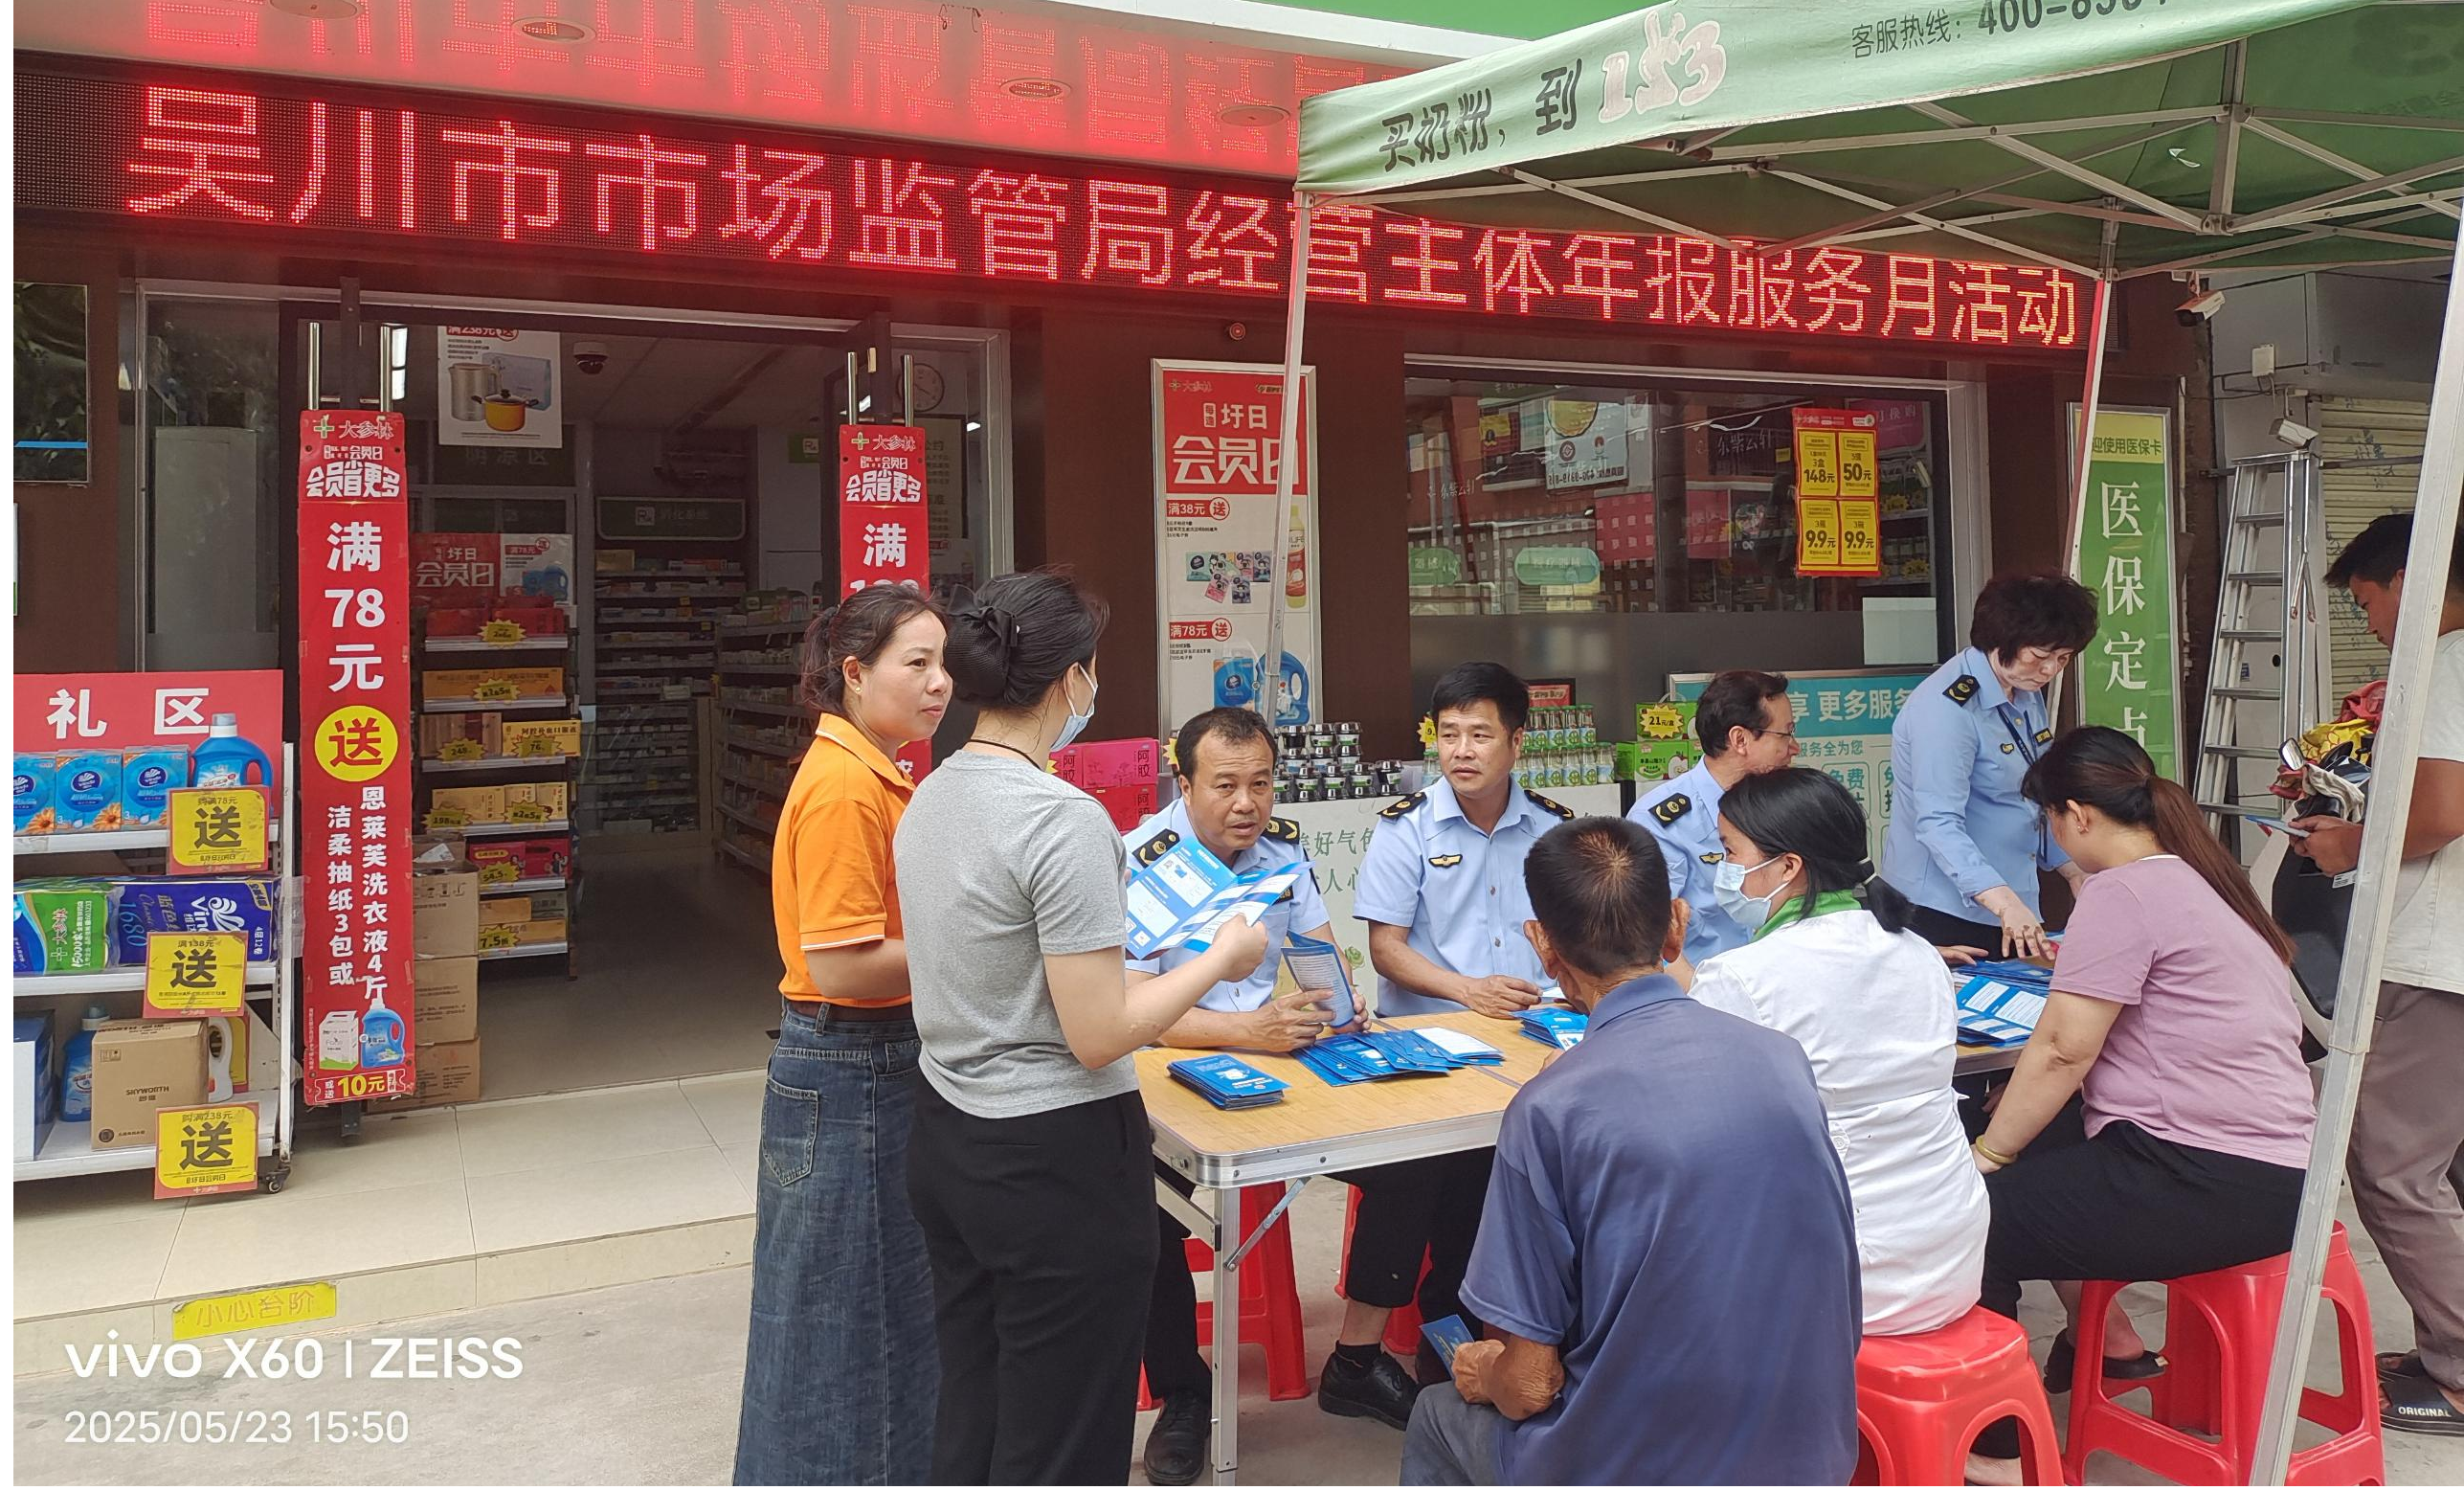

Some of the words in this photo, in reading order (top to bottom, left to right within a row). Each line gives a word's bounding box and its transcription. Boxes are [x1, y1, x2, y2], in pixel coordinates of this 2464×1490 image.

[1978, 0, 2166, 35] 400-8
[126, 84, 2077, 350] 吴川市市场监管局经营主体年报服务月活动
[339, 420, 393, 440] 大参林
[1221, 403, 1267, 429] 圩日
[1173, 435, 1299, 485] 会员日
[1843, 463, 1872, 482] 50元
[306, 460, 400, 498] 会员省更多
[845, 469, 922, 503] 会员省更多
[1803, 469, 1835, 484] 148元
[1168, 503, 1205, 516] 满38元
[1212, 502, 1227, 518] 送
[862, 523, 907, 568] 满
[1805, 530, 1836, 549] 9.9元
[1844, 531, 1874, 550] 9.9元
[415, 561, 495, 588] 会员日
[1170, 625, 1208, 638] 满78元
[1214, 621, 1230, 639] 送
[328, 717, 384, 767] 送
[1063, 755, 1076, 783] 阿胶
[1137, 749, 1152, 778] 阿胶
[193, 805, 242, 849] 送
[327, 805, 354, 986] 洁柔抽纸3包或
[360, 785, 389, 1000] 恩莱芙洗衣液4斤
[170, 948, 217, 988] 送
[337, 1073, 385, 1097] 10元
[179, 1121, 234, 1170] 送
[196, 1289, 315, 1329] 小心台阶
[2398, 1406, 2452, 1418] ORIGINAL
